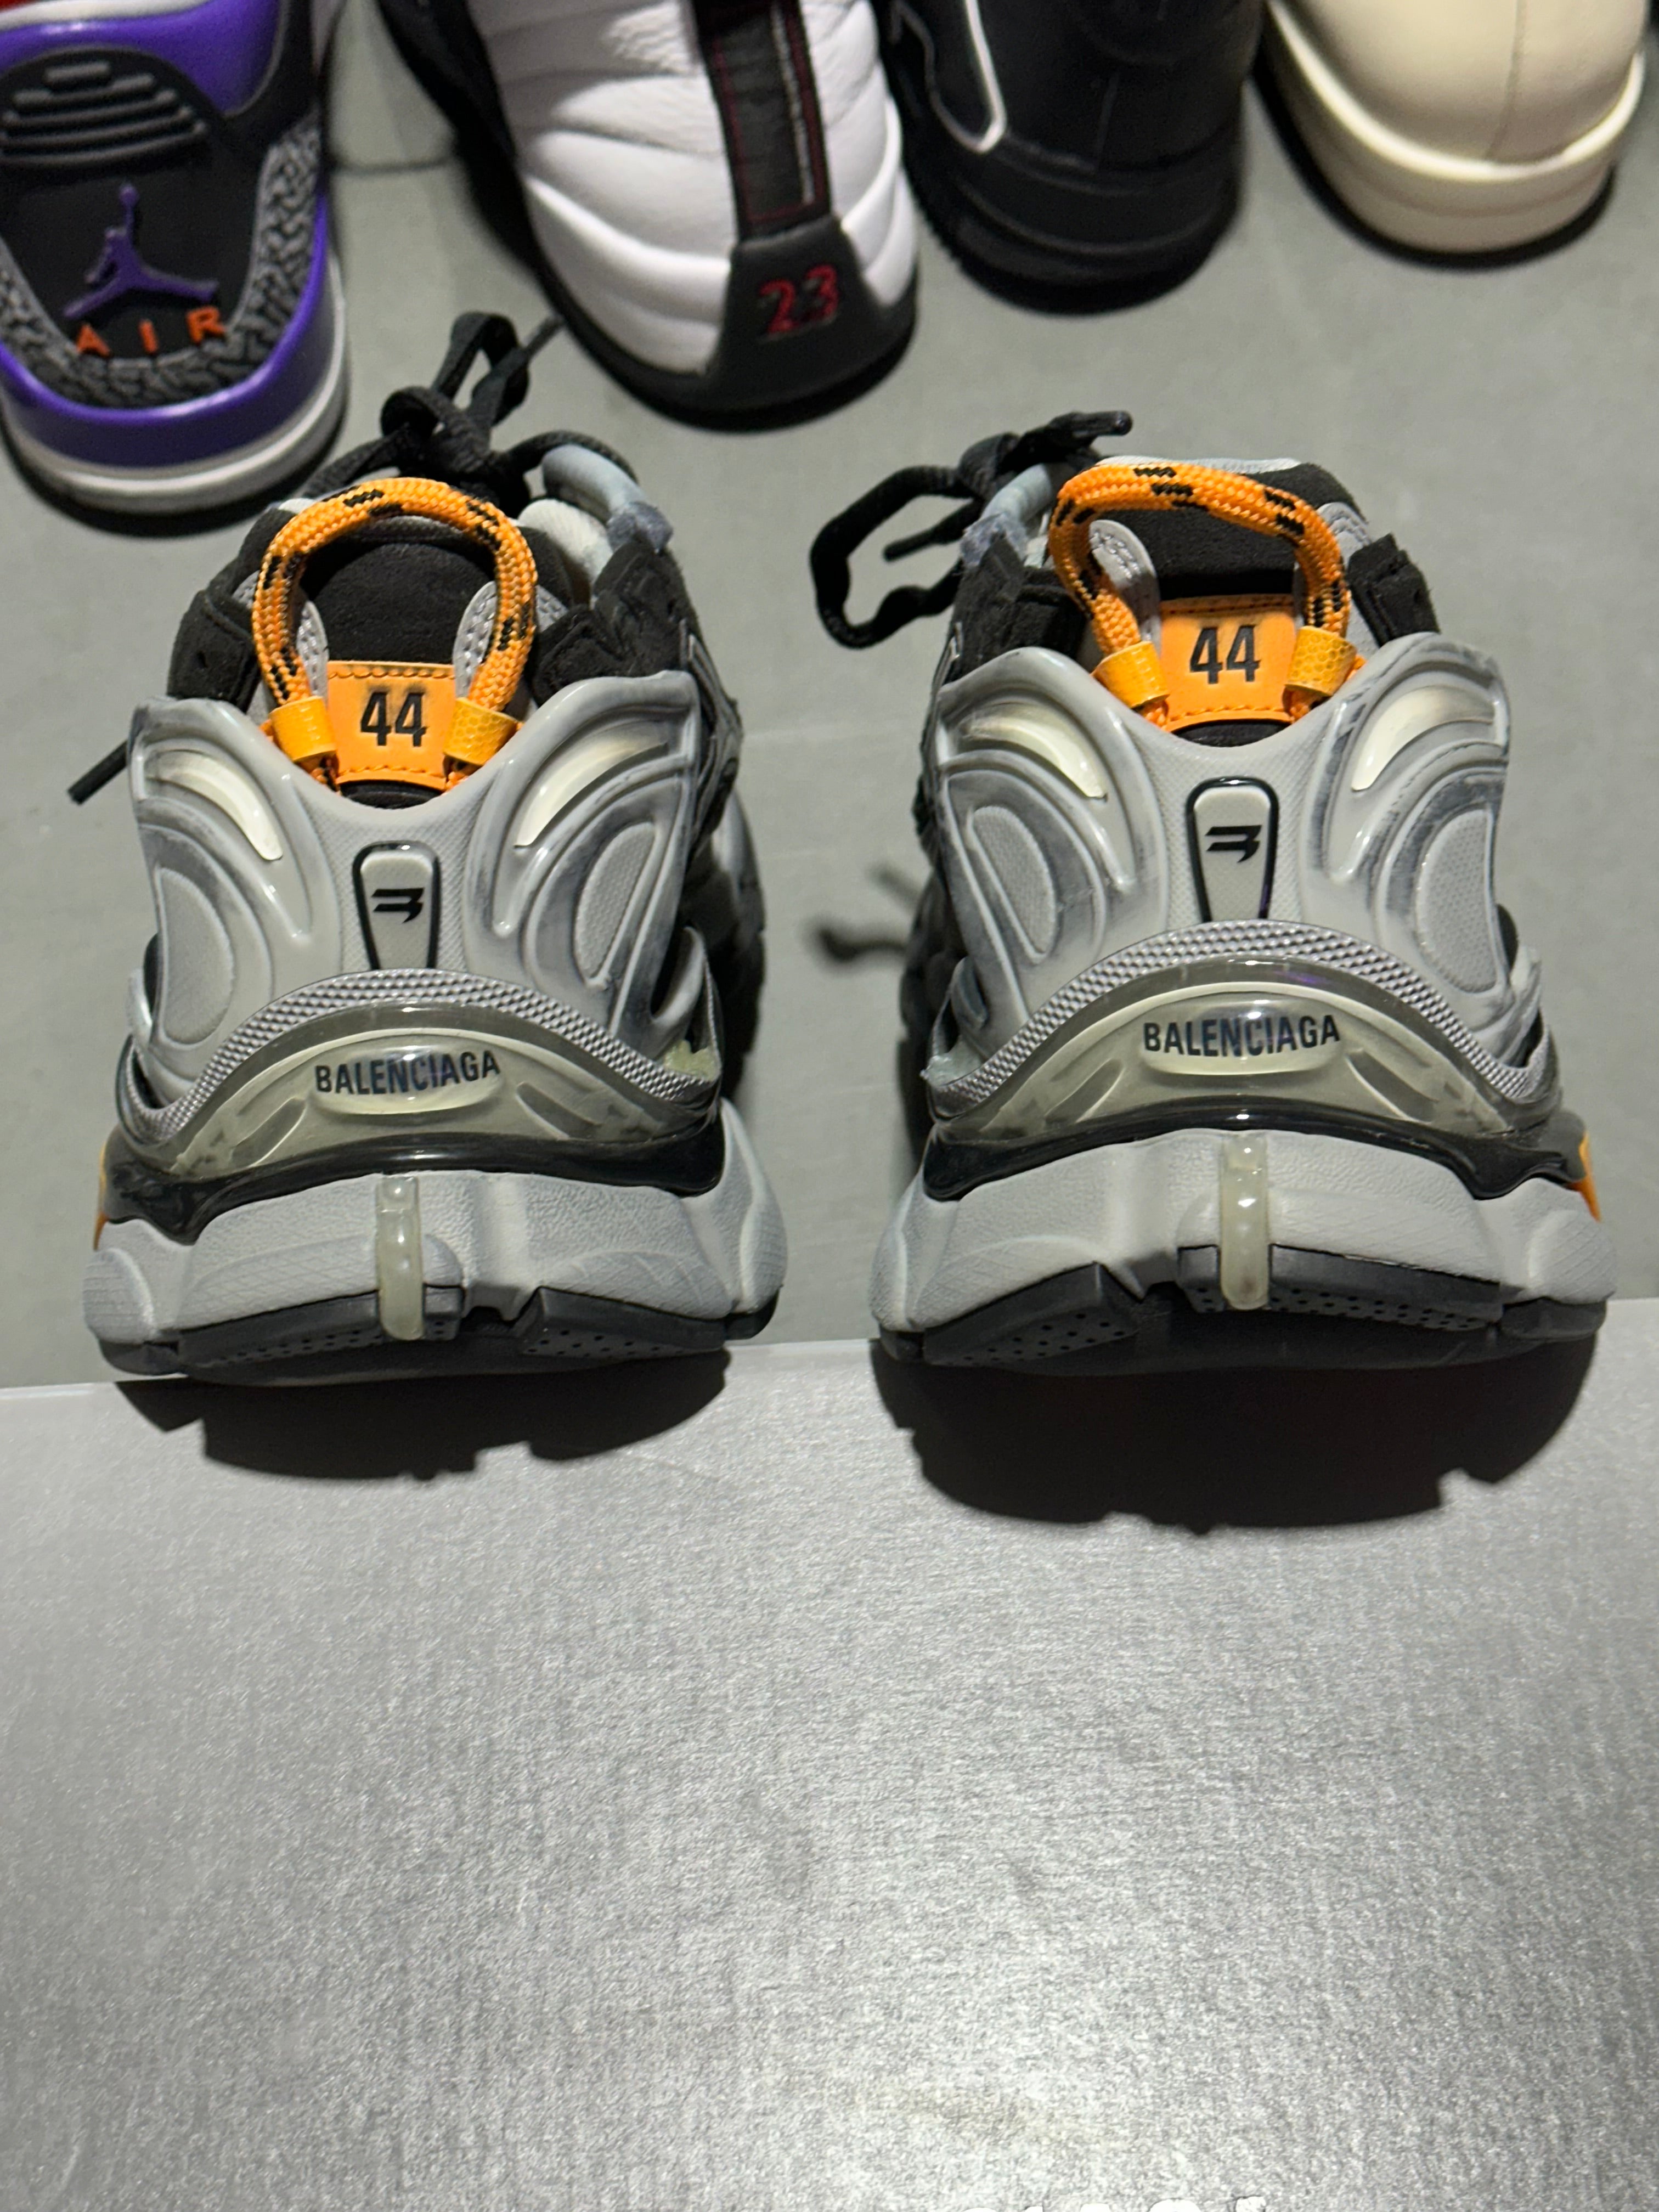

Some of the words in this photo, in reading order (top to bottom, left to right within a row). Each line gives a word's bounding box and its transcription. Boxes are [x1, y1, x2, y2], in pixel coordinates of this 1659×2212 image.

[760, 264, 839, 335] 23
[77, 306, 224, 356] AIR
[1189, 624, 1261, 685] 44
[360, 691, 428, 747] 44
[1143, 1015, 1340, 1058] BALENCIAGA
[314, 1050, 501, 1095] BALENCIAGA
